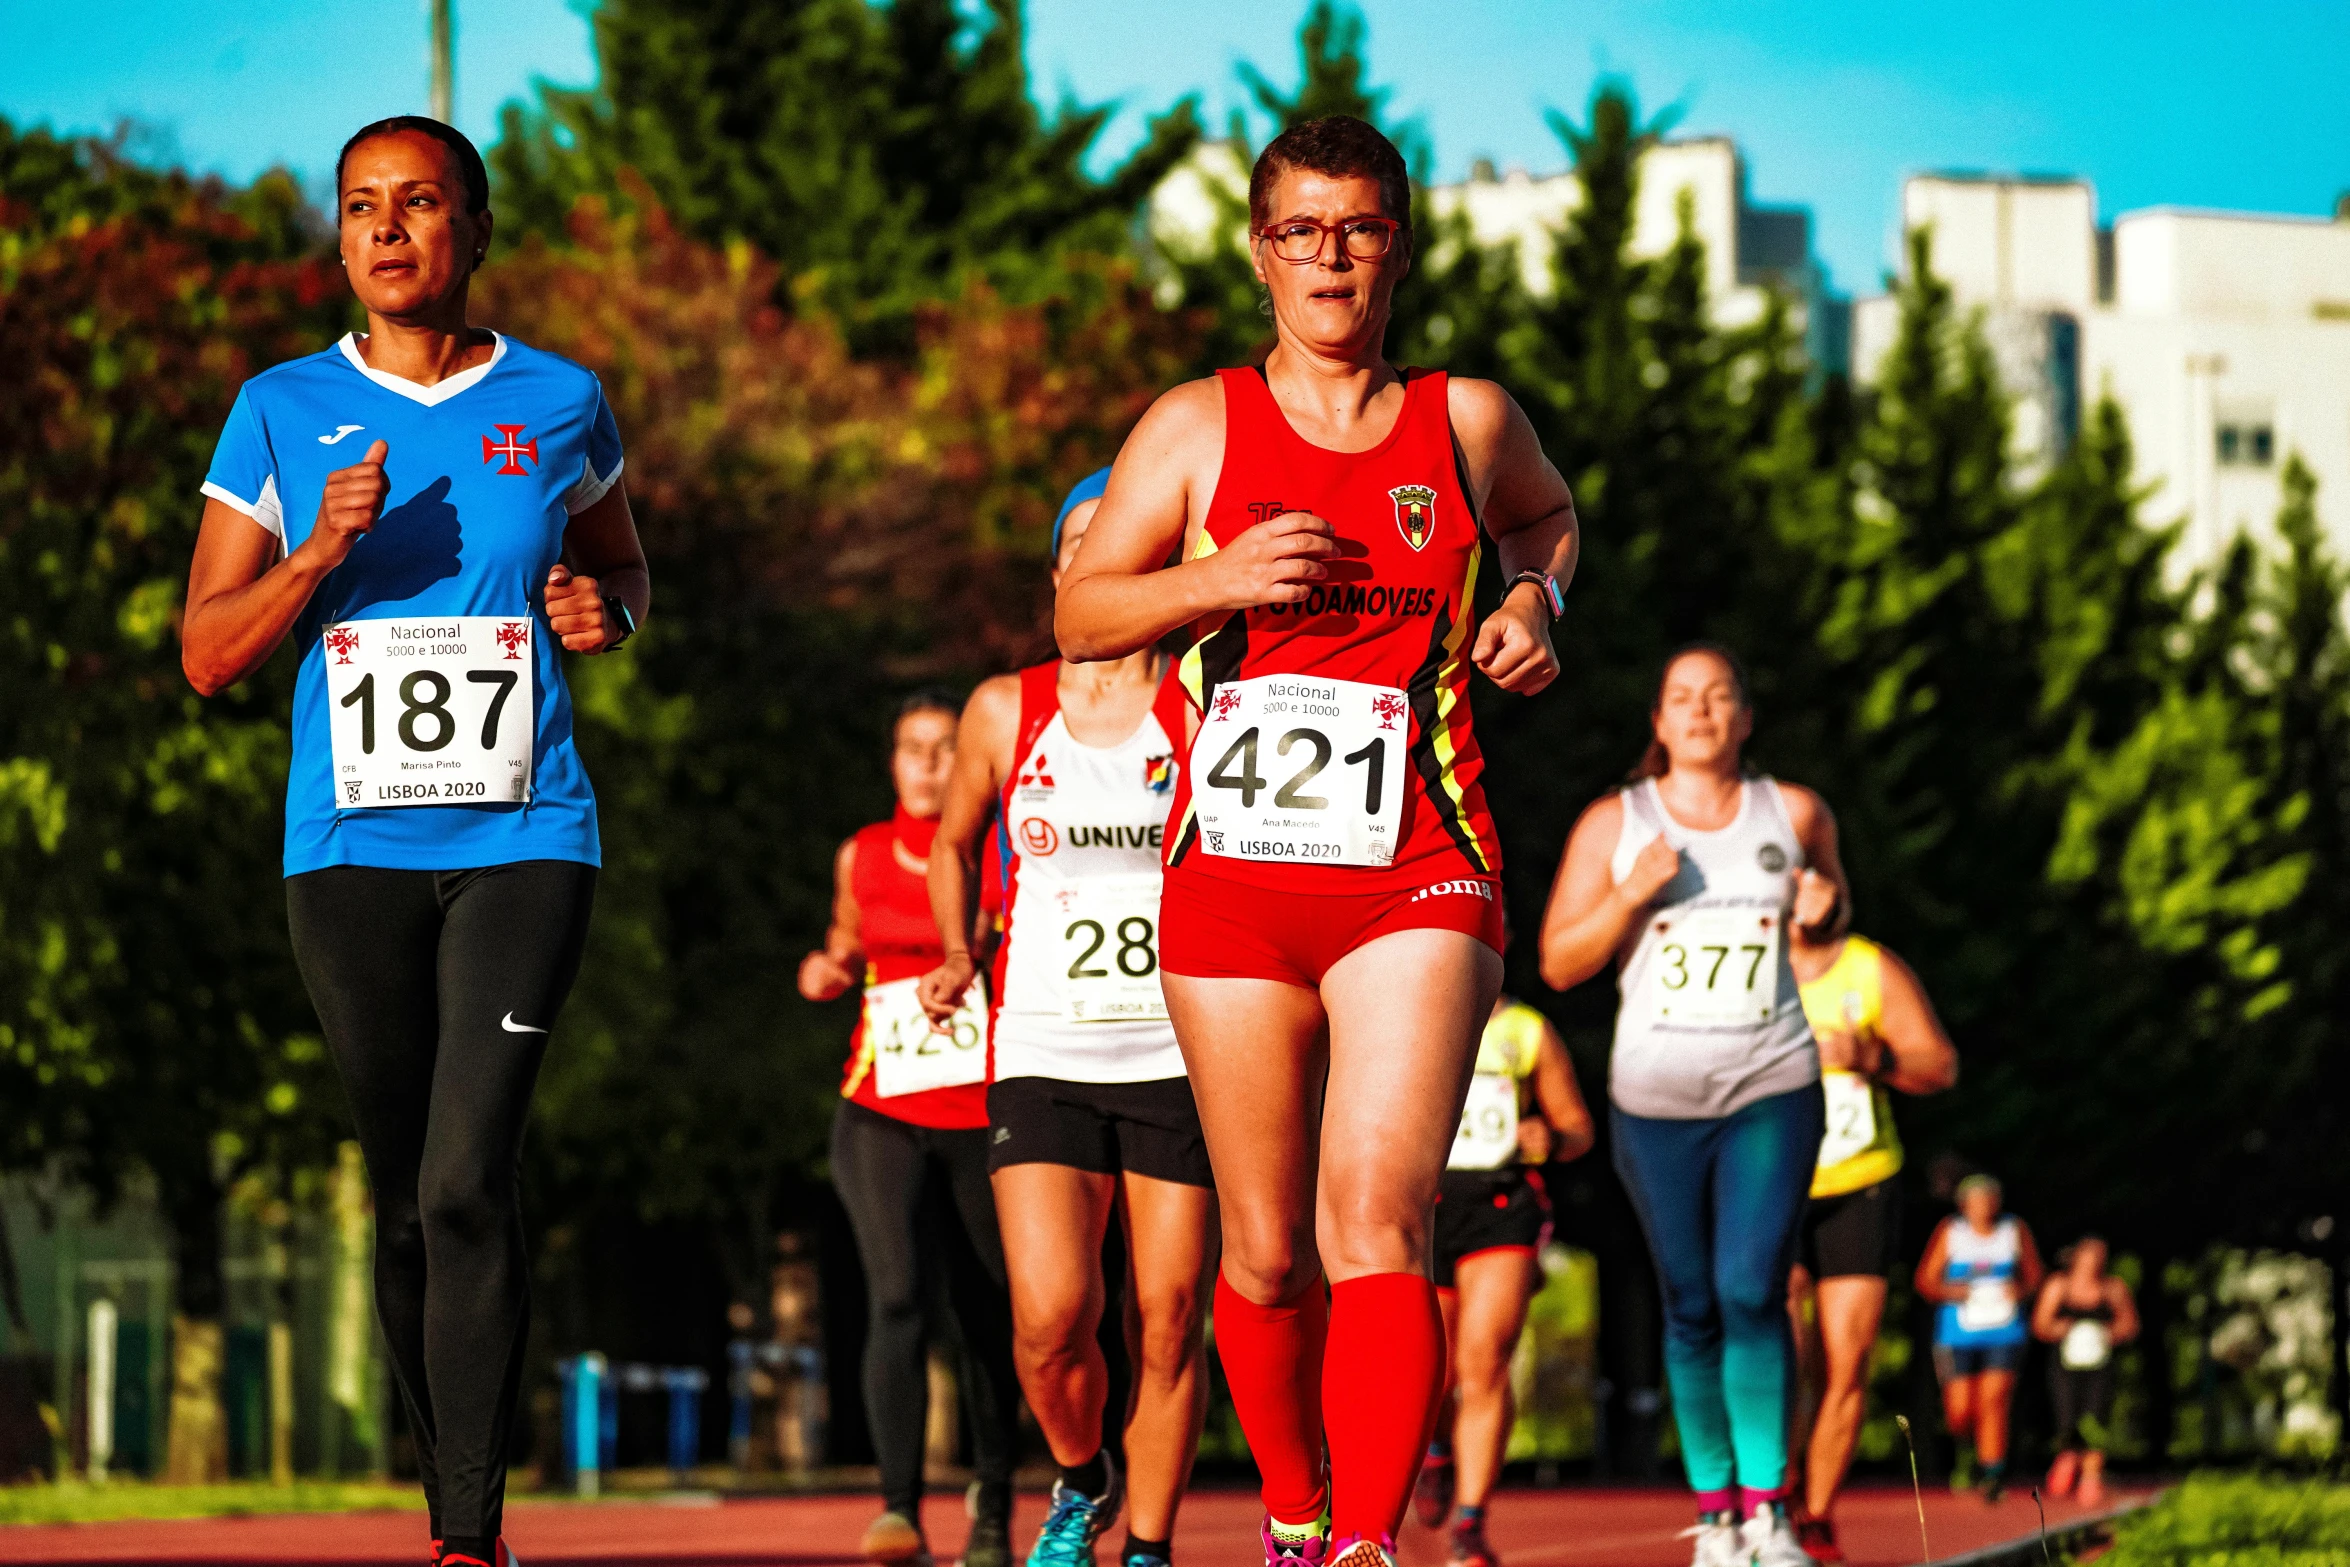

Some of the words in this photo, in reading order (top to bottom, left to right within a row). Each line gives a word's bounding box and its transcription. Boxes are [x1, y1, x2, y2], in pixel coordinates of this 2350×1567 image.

[1253, 585, 1436, 617] OAMOVEIS
[390, 623, 462, 641] Nacional
[386, 645, 415, 657] 5000
[418, 646, 426, 656] e
[430, 643, 467, 656] 10000
[1268, 683, 1336, 701] Nacional
[340, 669, 519, 755] 187
[1263, 701, 1288, 715] 5000
[1291, 705, 1298, 713] e
[1302, 703, 1340, 718] 10000
[342, 764, 357, 774] CFB
[401, 761, 434, 771] Marisa
[436, 759, 462, 770] Pinto
[508, 759, 523, 768] V45
[1206, 726, 1386, 816] 421
[378, 783, 440, 800] LISBOA
[444, 781, 486, 798] 2020
[1203, 815, 1219, 824] UAP
[1262, 818, 1281, 828] Ana
[1282, 818, 1321, 829] Macedo
[1068, 825, 1164, 849] UNIVE
[1368, 824, 1386, 834] V45
[1239, 840, 1296, 857] LISBOA
[1300, 843, 1342, 859] 2020
[1065, 916, 1157, 979] 28
[1661, 943, 1768, 992] 377
[1462, 1106, 1506, 1143] 9
